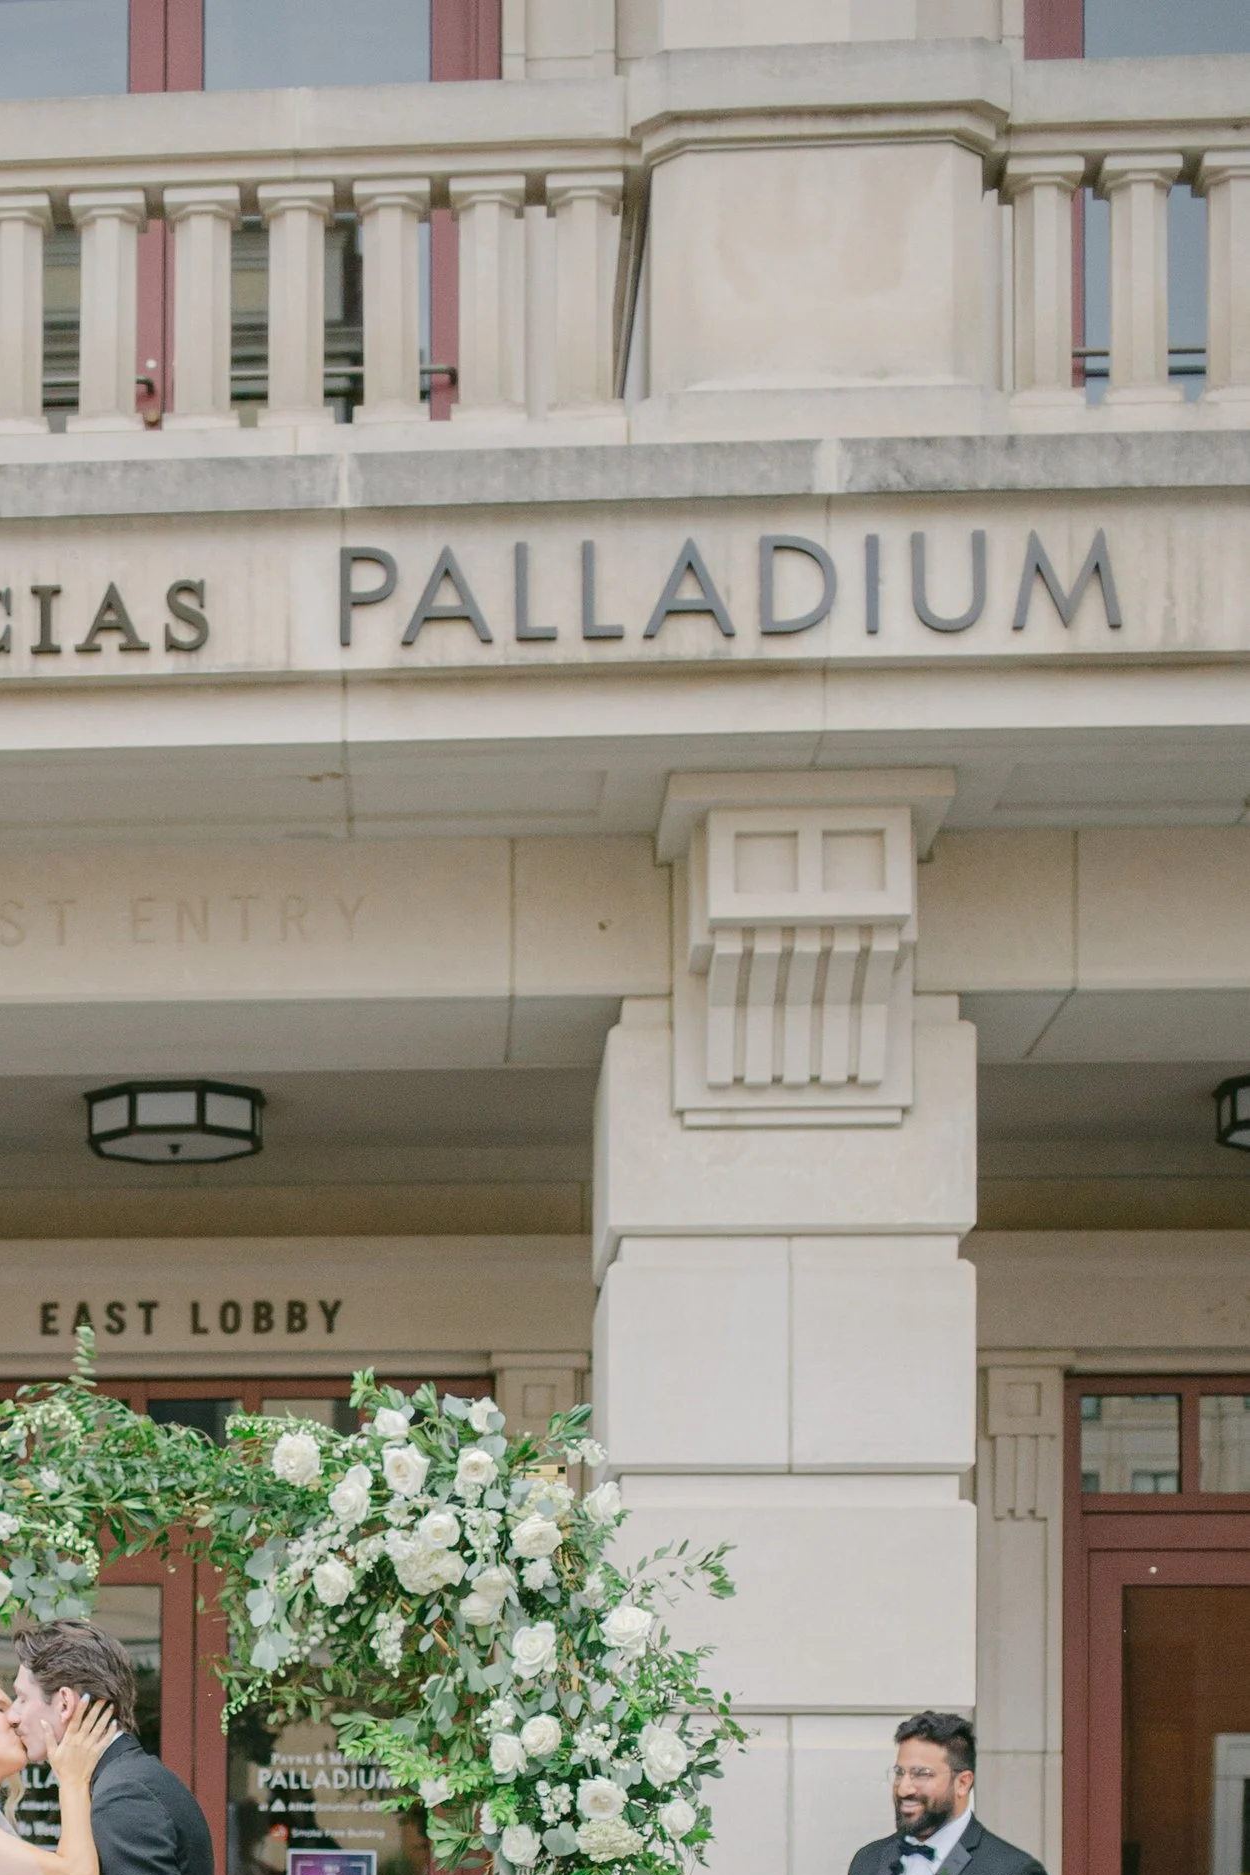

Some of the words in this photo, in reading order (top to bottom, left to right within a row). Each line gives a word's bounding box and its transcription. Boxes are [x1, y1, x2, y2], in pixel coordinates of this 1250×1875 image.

[339, 527, 1122, 647] PALLADIUM
[129, 893, 367, 945] ENTRY
[39, 1300, 159, 1336] EAST
[190, 1299, 343, 1335] LOBBY
